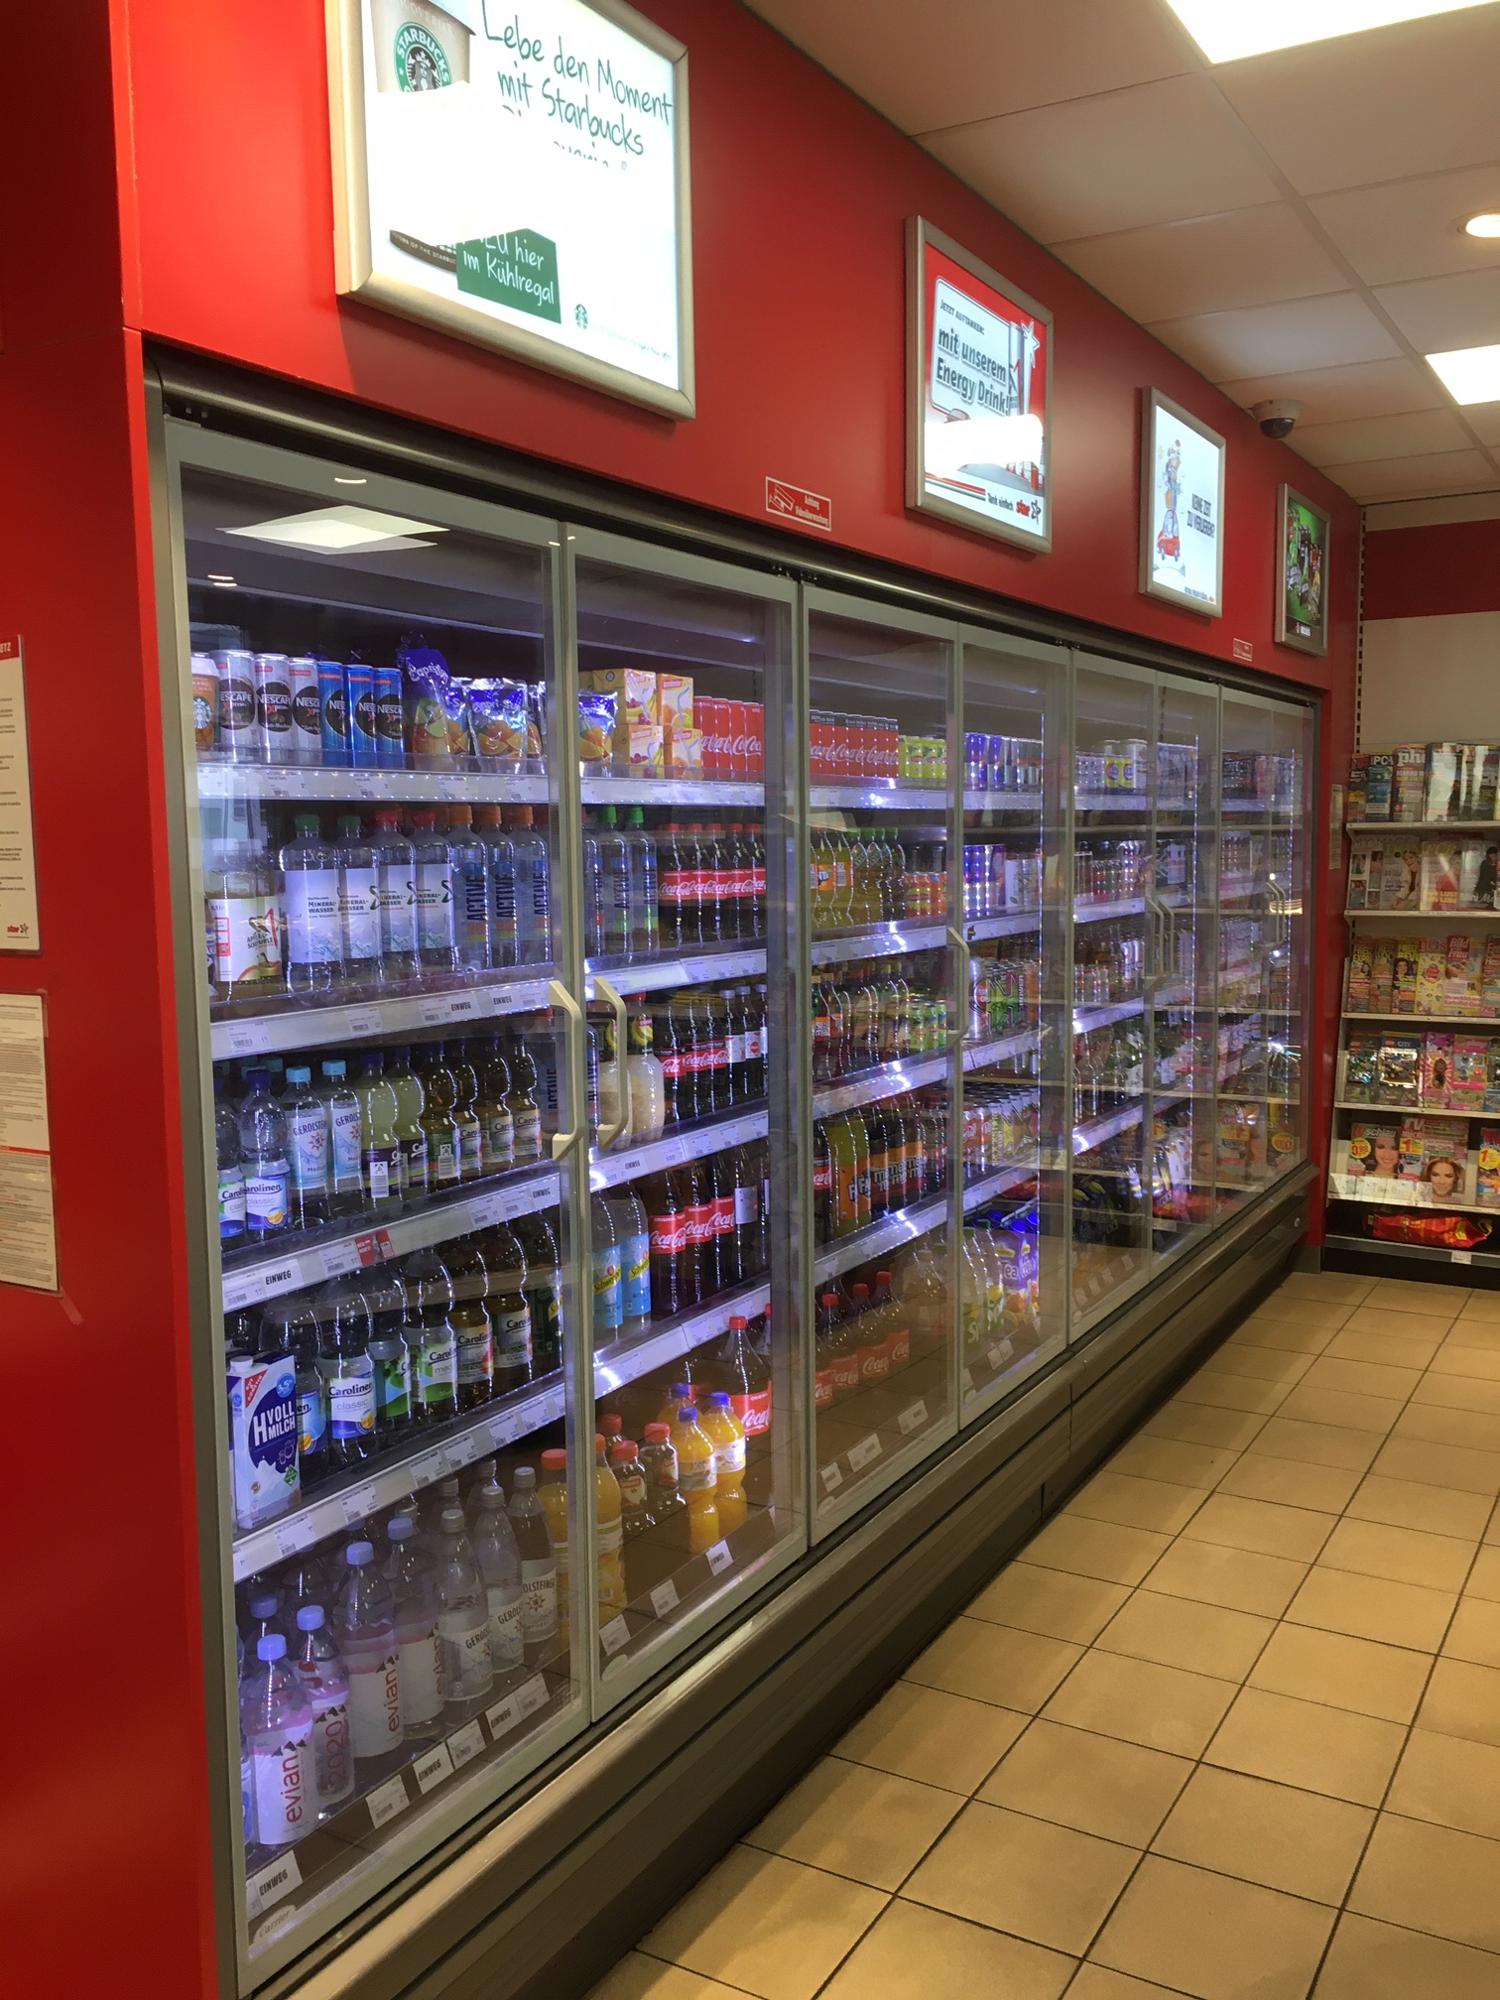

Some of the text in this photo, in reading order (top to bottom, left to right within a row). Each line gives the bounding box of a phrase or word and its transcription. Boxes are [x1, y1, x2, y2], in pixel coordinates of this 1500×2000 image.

[397, 28, 450, 82] STARBUCKS
[481, 0, 673, 126] Lebe den Moment
[498, 60, 533, 109] mit
[541, 77, 644, 156] Starbucks
[486, 251, 556, 307] Kühlregal
[514, 236, 545, 271] hier
[938, 328, 1007, 382] mit unserem
[936, 356, 1010, 417] Energy Drink!
[265, 1269, 293, 1286] EINWEG
[253, 1400, 295, 1447] H VOLL
[267, 1415, 296, 1440] MILCH
[384, 1666, 400, 1733] evian
[280, 1752, 303, 1824] evian
[259, 1869, 289, 1897] EINWEG
